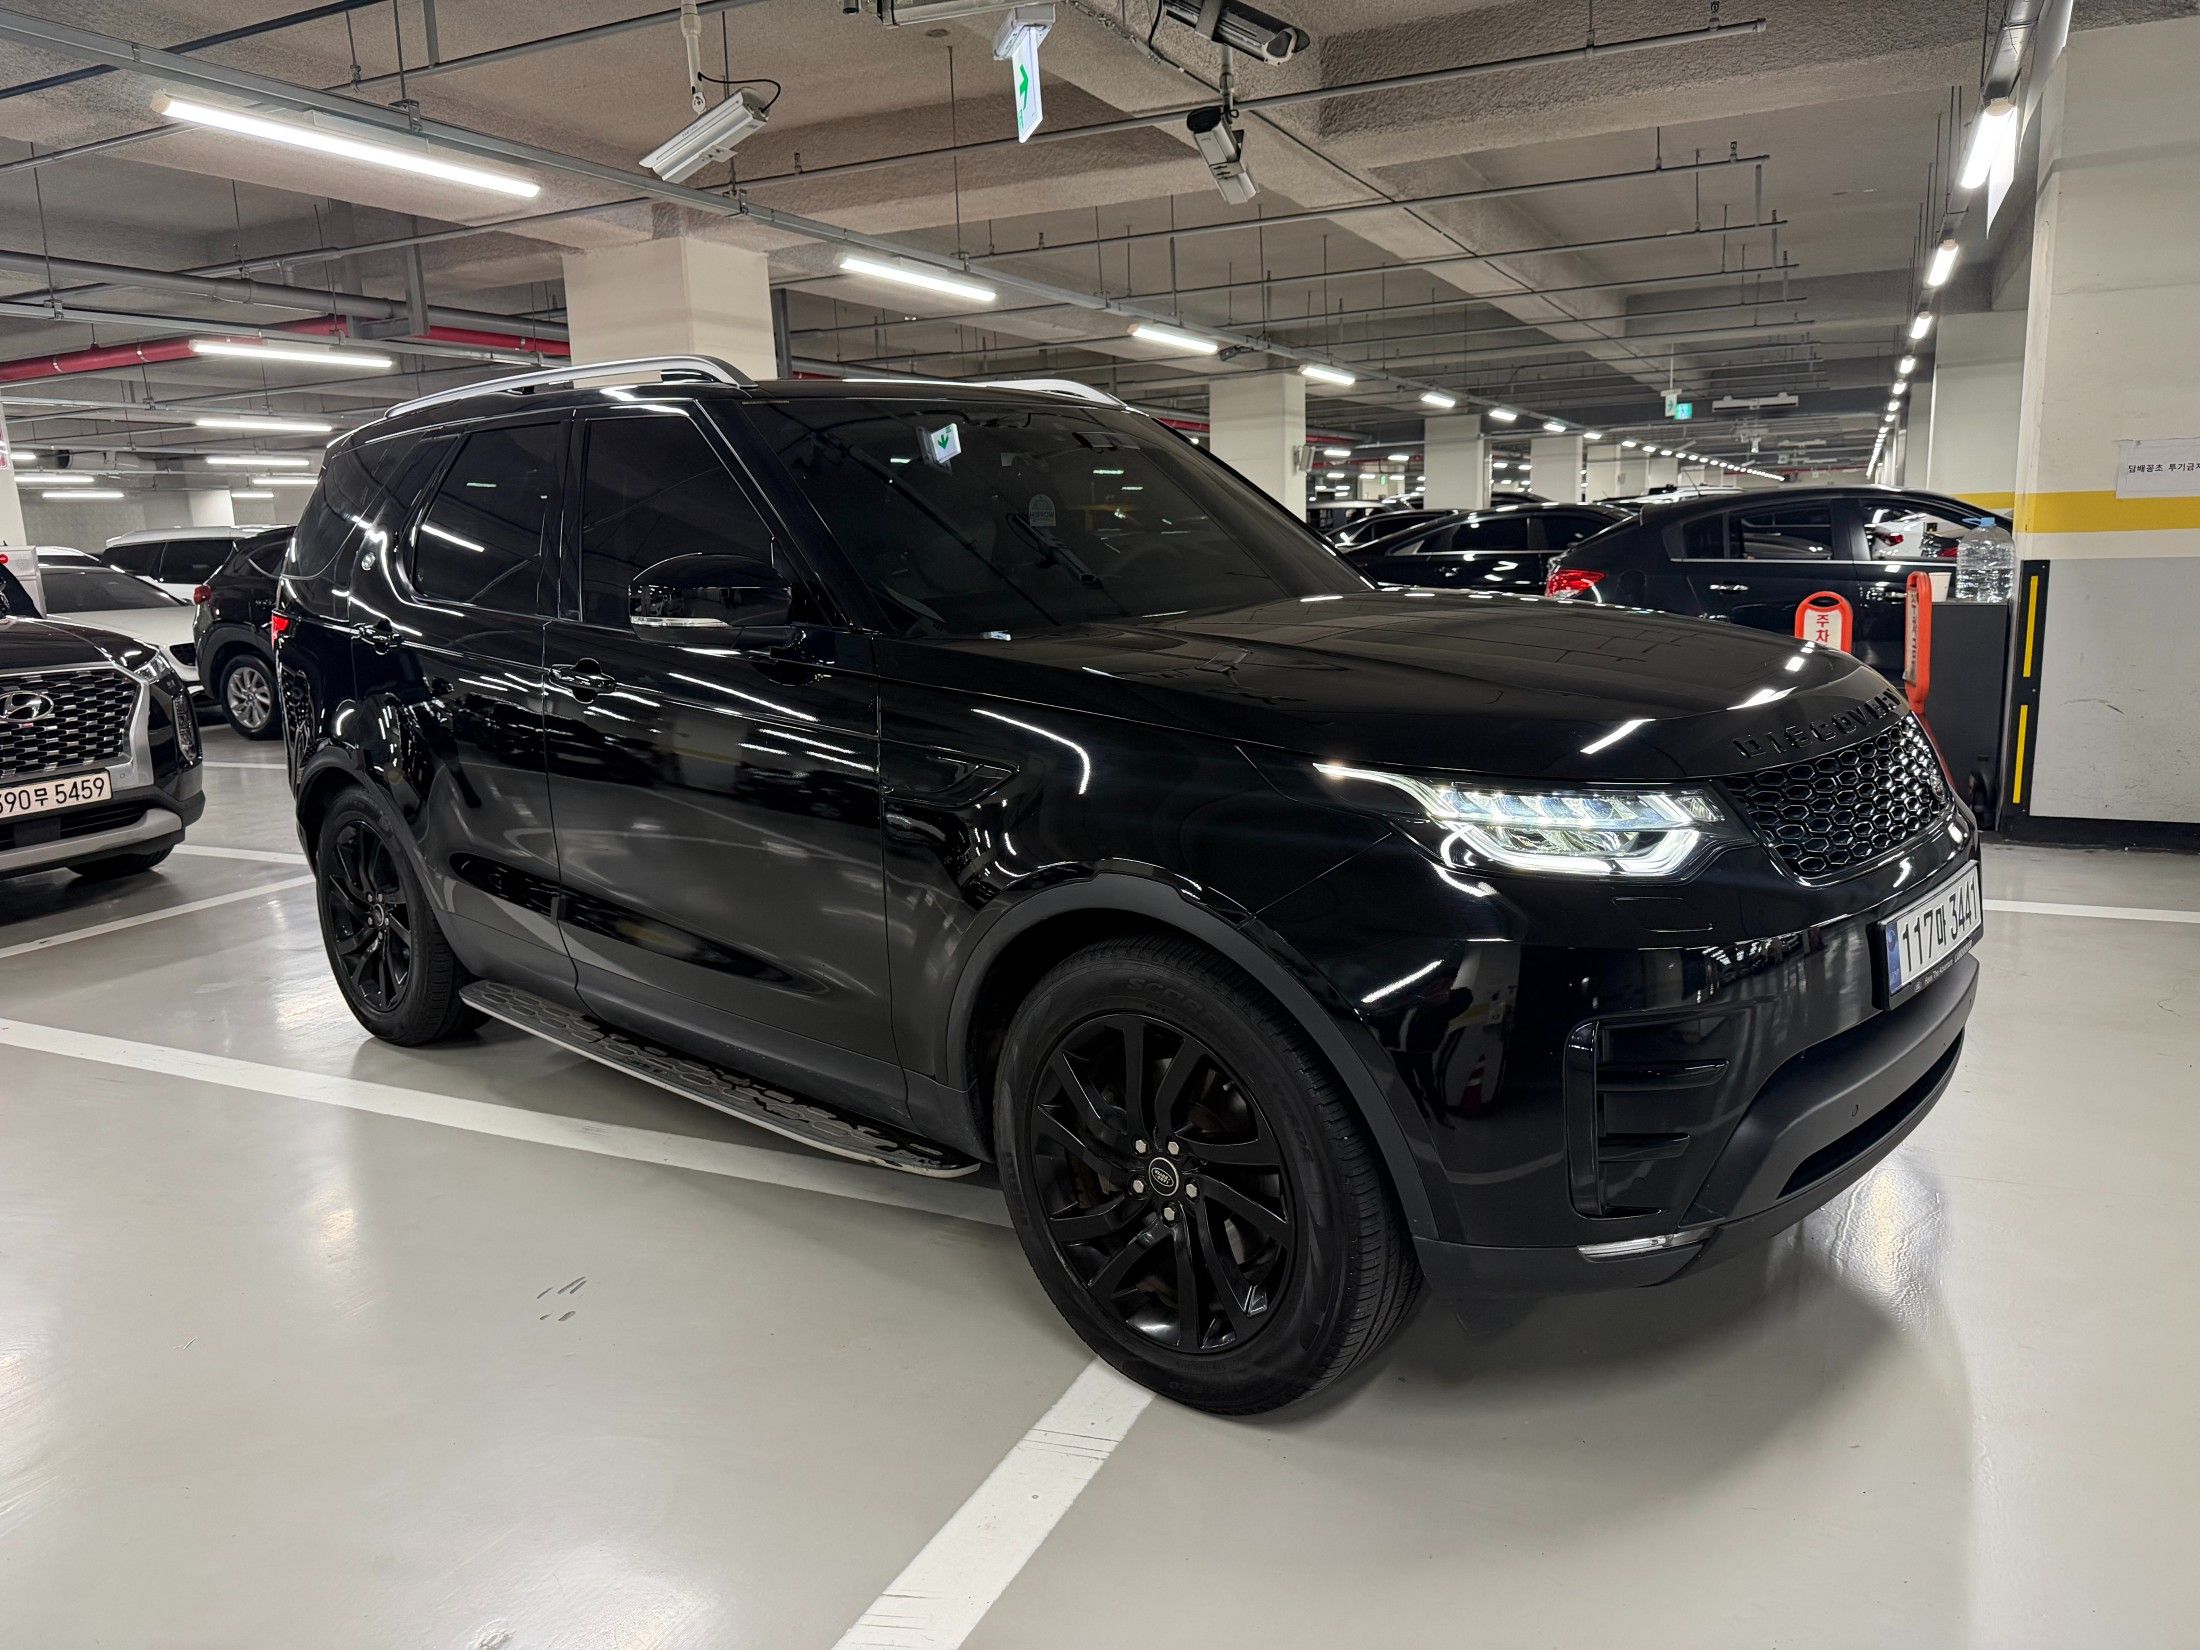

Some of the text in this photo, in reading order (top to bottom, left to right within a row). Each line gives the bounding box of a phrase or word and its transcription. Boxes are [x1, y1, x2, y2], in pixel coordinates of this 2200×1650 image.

[1816, 614, 1830, 643] 주차
[55, 777, 105, 804] 5459
[1949, 876, 1977, 940] 3441
